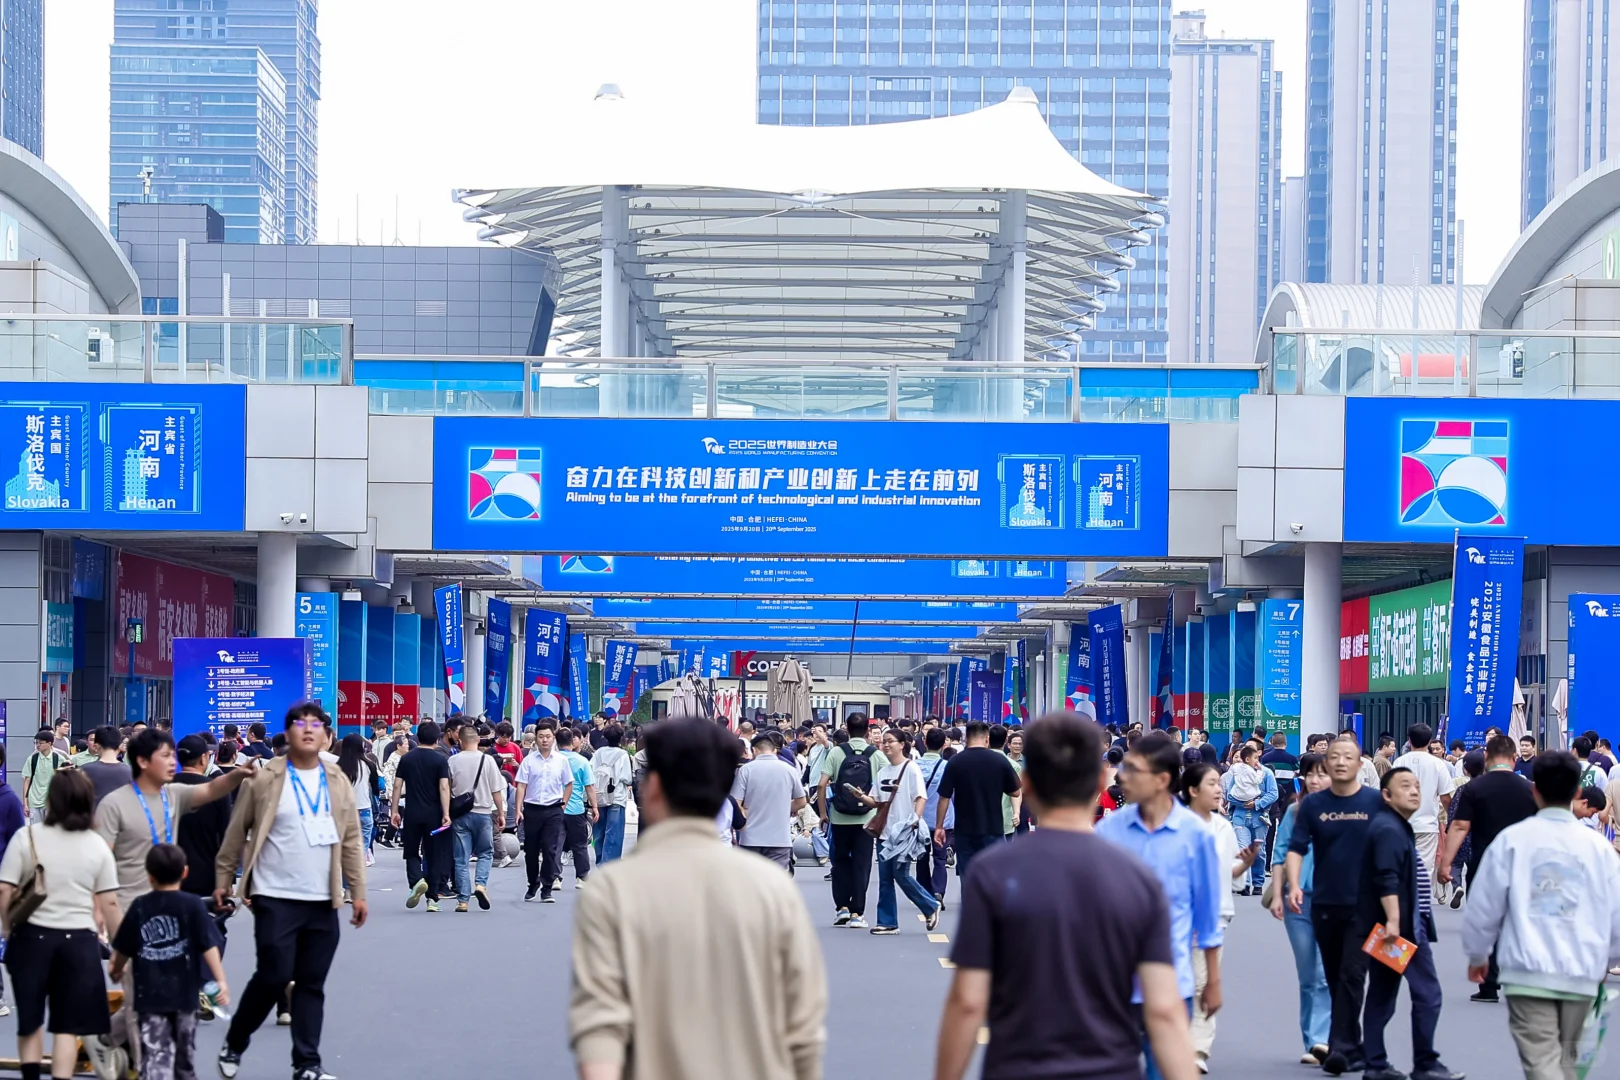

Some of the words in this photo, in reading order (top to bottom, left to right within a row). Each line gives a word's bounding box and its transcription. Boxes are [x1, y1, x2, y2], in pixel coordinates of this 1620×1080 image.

[50, 416, 62, 454] 主宾国
[164, 416, 176, 455] 主宾省
[728, 440, 838, 450] 2025世界制造业大会
[26, 414, 45, 490] 斯洛伐克
[138, 429, 161, 479] 河南
[566, 466, 979, 492] 奋力在科技创新和产业创新上走在前列
[1022, 463, 1036, 515] 斯洛伐克
[1098, 473, 1113, 506] 河南
[8, 496, 70, 508] Slovakia
[126, 496, 176, 508] Henan
[566, 492, 606, 505] Aiming
[609, 492, 621, 502] to
[625, 492, 639, 502] be
[643, 493, 655, 503] at
[658, 493, 677, 503] the
[681, 493, 738, 503] forefront
[741, 494, 754, 504] of
[757, 494, 834, 506] technological
[837, 495, 858, 504] and
[862, 495, 916, 505] industrial
[920, 495, 980, 506] innovation
[1011, 517, 1052, 526] Slovakia
[1090, 518, 1123, 526] Henan
[300, 597, 311, 614] 5
[1287, 603, 1300, 620] 7
[536, 623, 552, 657] 河南
[552, 617, 561, 644] 主宾省
[1078, 637, 1090, 668] 河南
[1475, 581, 1493, 716] 2025安徽食品工业博览会
[611, 645, 625, 681] 斯洛伐克
[1489, 654, 1498, 692] INDUSTRY
[1266, 720, 1298, 730] 世纪华
[1328, 811, 1369, 820] Columbia
